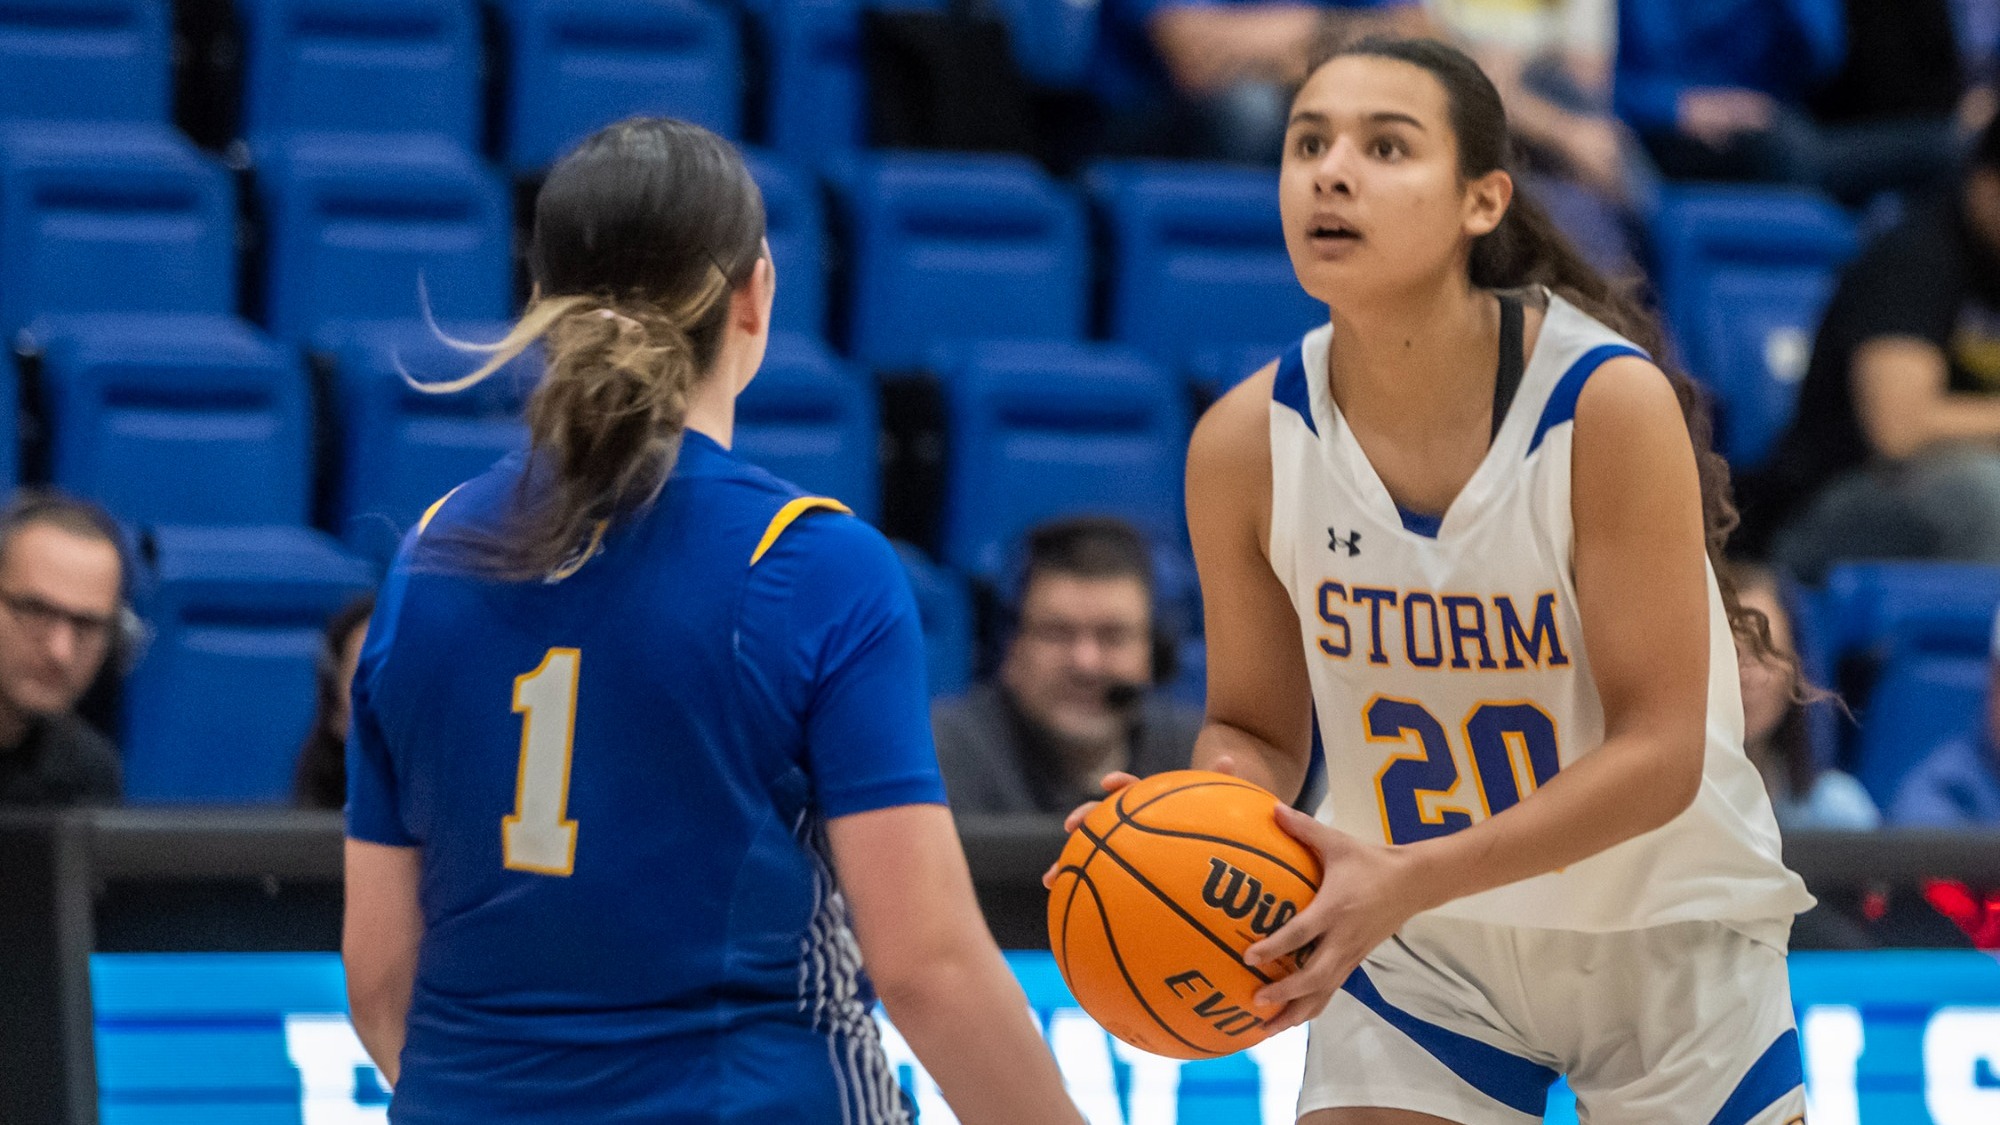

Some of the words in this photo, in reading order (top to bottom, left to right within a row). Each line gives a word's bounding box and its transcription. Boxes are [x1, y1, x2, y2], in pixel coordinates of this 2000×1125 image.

[1315, 577, 1571, 672] STORM
[502, 646, 582, 877] 1
[1361, 692, 1561, 846] 20
[1200, 855, 1306, 950] Wil
